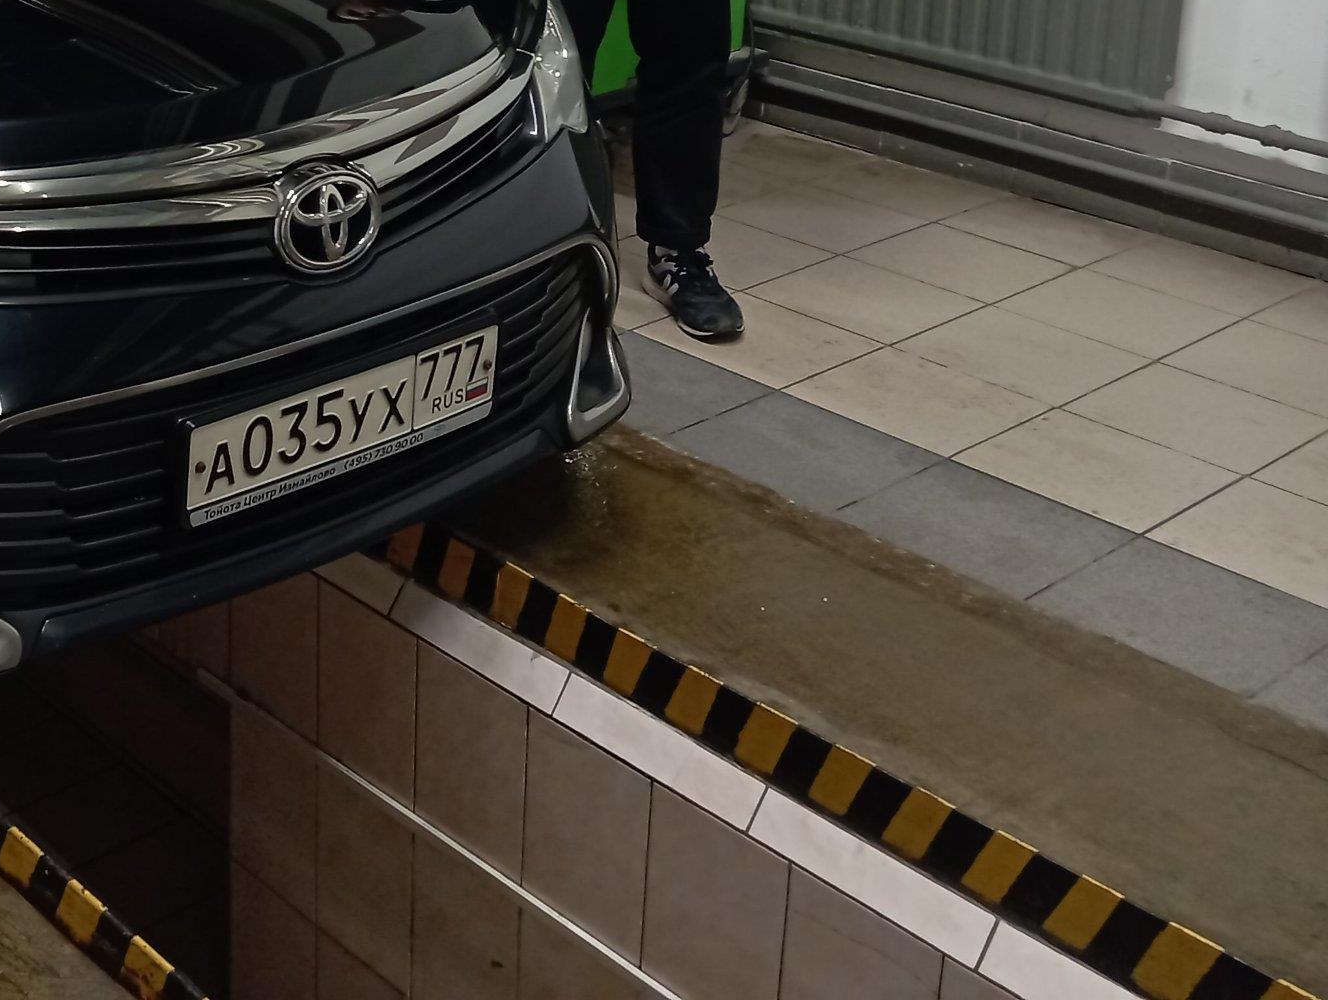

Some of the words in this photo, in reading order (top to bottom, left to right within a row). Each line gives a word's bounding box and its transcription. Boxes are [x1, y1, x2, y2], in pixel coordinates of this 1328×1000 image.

[204, 378, 408, 496] А035УХ
[418, 335, 485, 401] 777
[431, 388, 465, 414] RUS
[204, 501, 241, 520] Тойота
[243, 488, 277, 507] Центр
[278, 466, 336, 495] Измайлово
[343, 454, 373, 471] (495)
